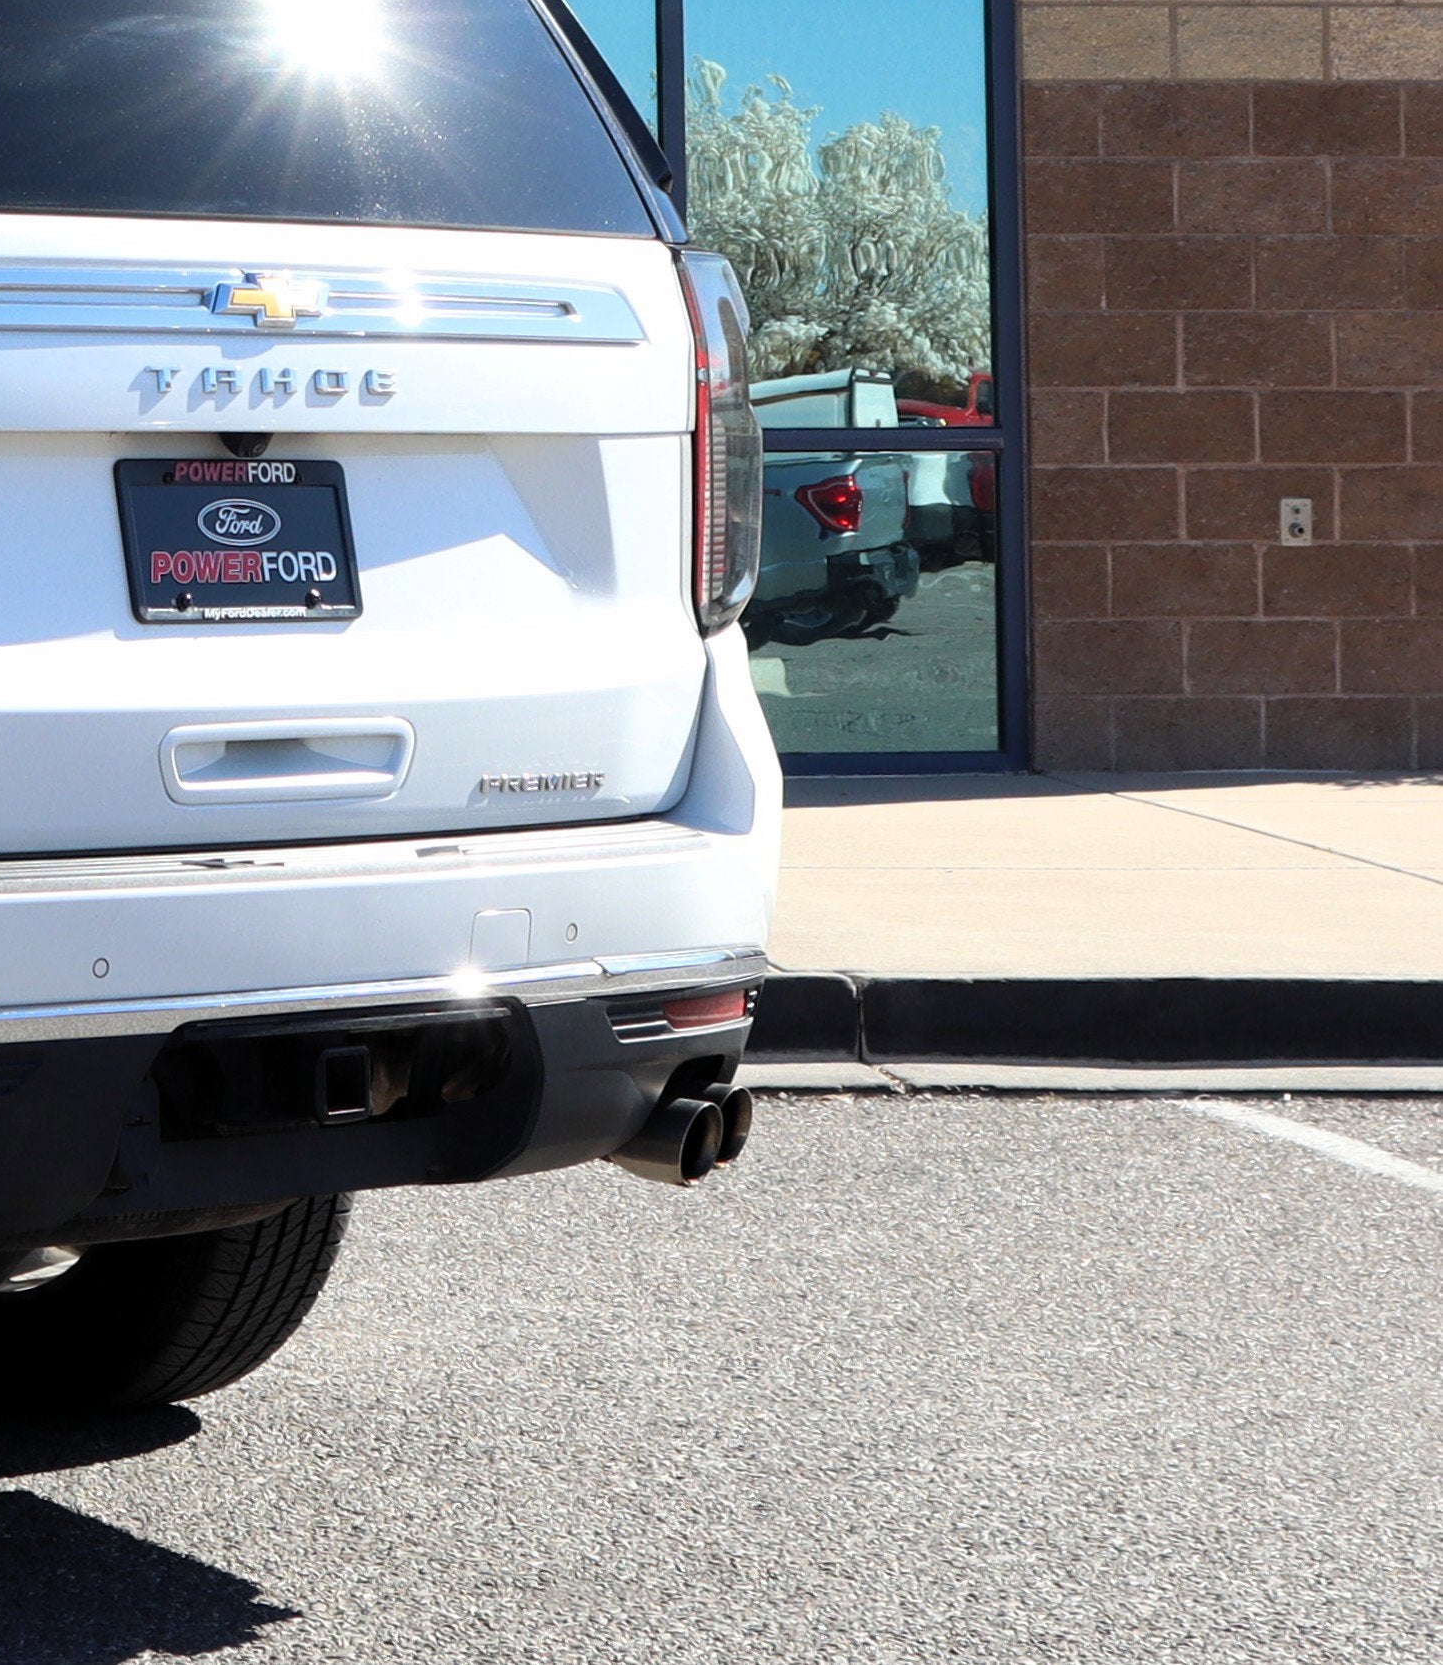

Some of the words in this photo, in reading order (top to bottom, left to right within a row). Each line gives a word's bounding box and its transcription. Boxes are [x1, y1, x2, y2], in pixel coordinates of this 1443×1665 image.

[144, 365, 398, 395] TAHOE
[174, 462, 296, 483] POWERFORD
[215, 507, 263, 534] Ford
[151, 551, 337, 583] POWERFORD
[204, 607, 307, 620] MyFordDealer.com
[480, 771, 606, 793] PREMIER
